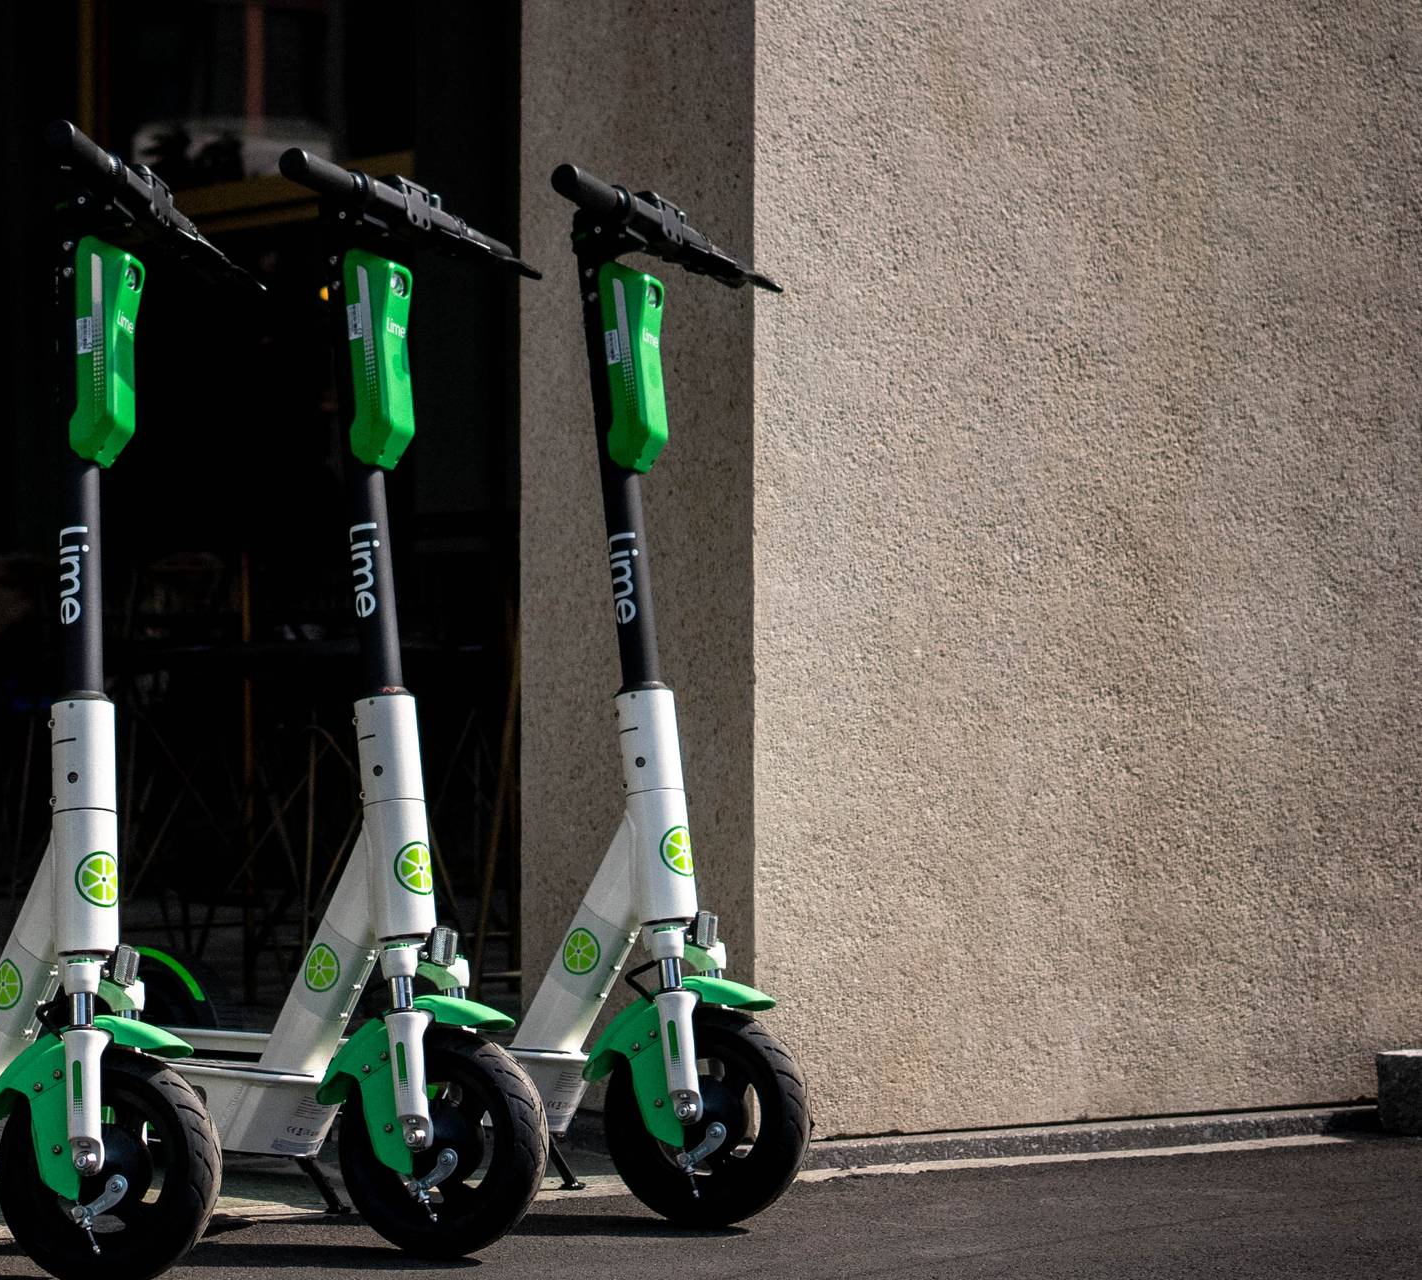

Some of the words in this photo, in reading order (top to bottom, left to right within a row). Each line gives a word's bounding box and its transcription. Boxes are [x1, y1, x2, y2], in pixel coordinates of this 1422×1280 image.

[117, 310, 134, 334] Lime
[386, 317, 406, 339] Lime
[59, 526, 90, 624] Lime
[349, 523, 380, 618] Lime
[609, 532, 639, 624] Lime
